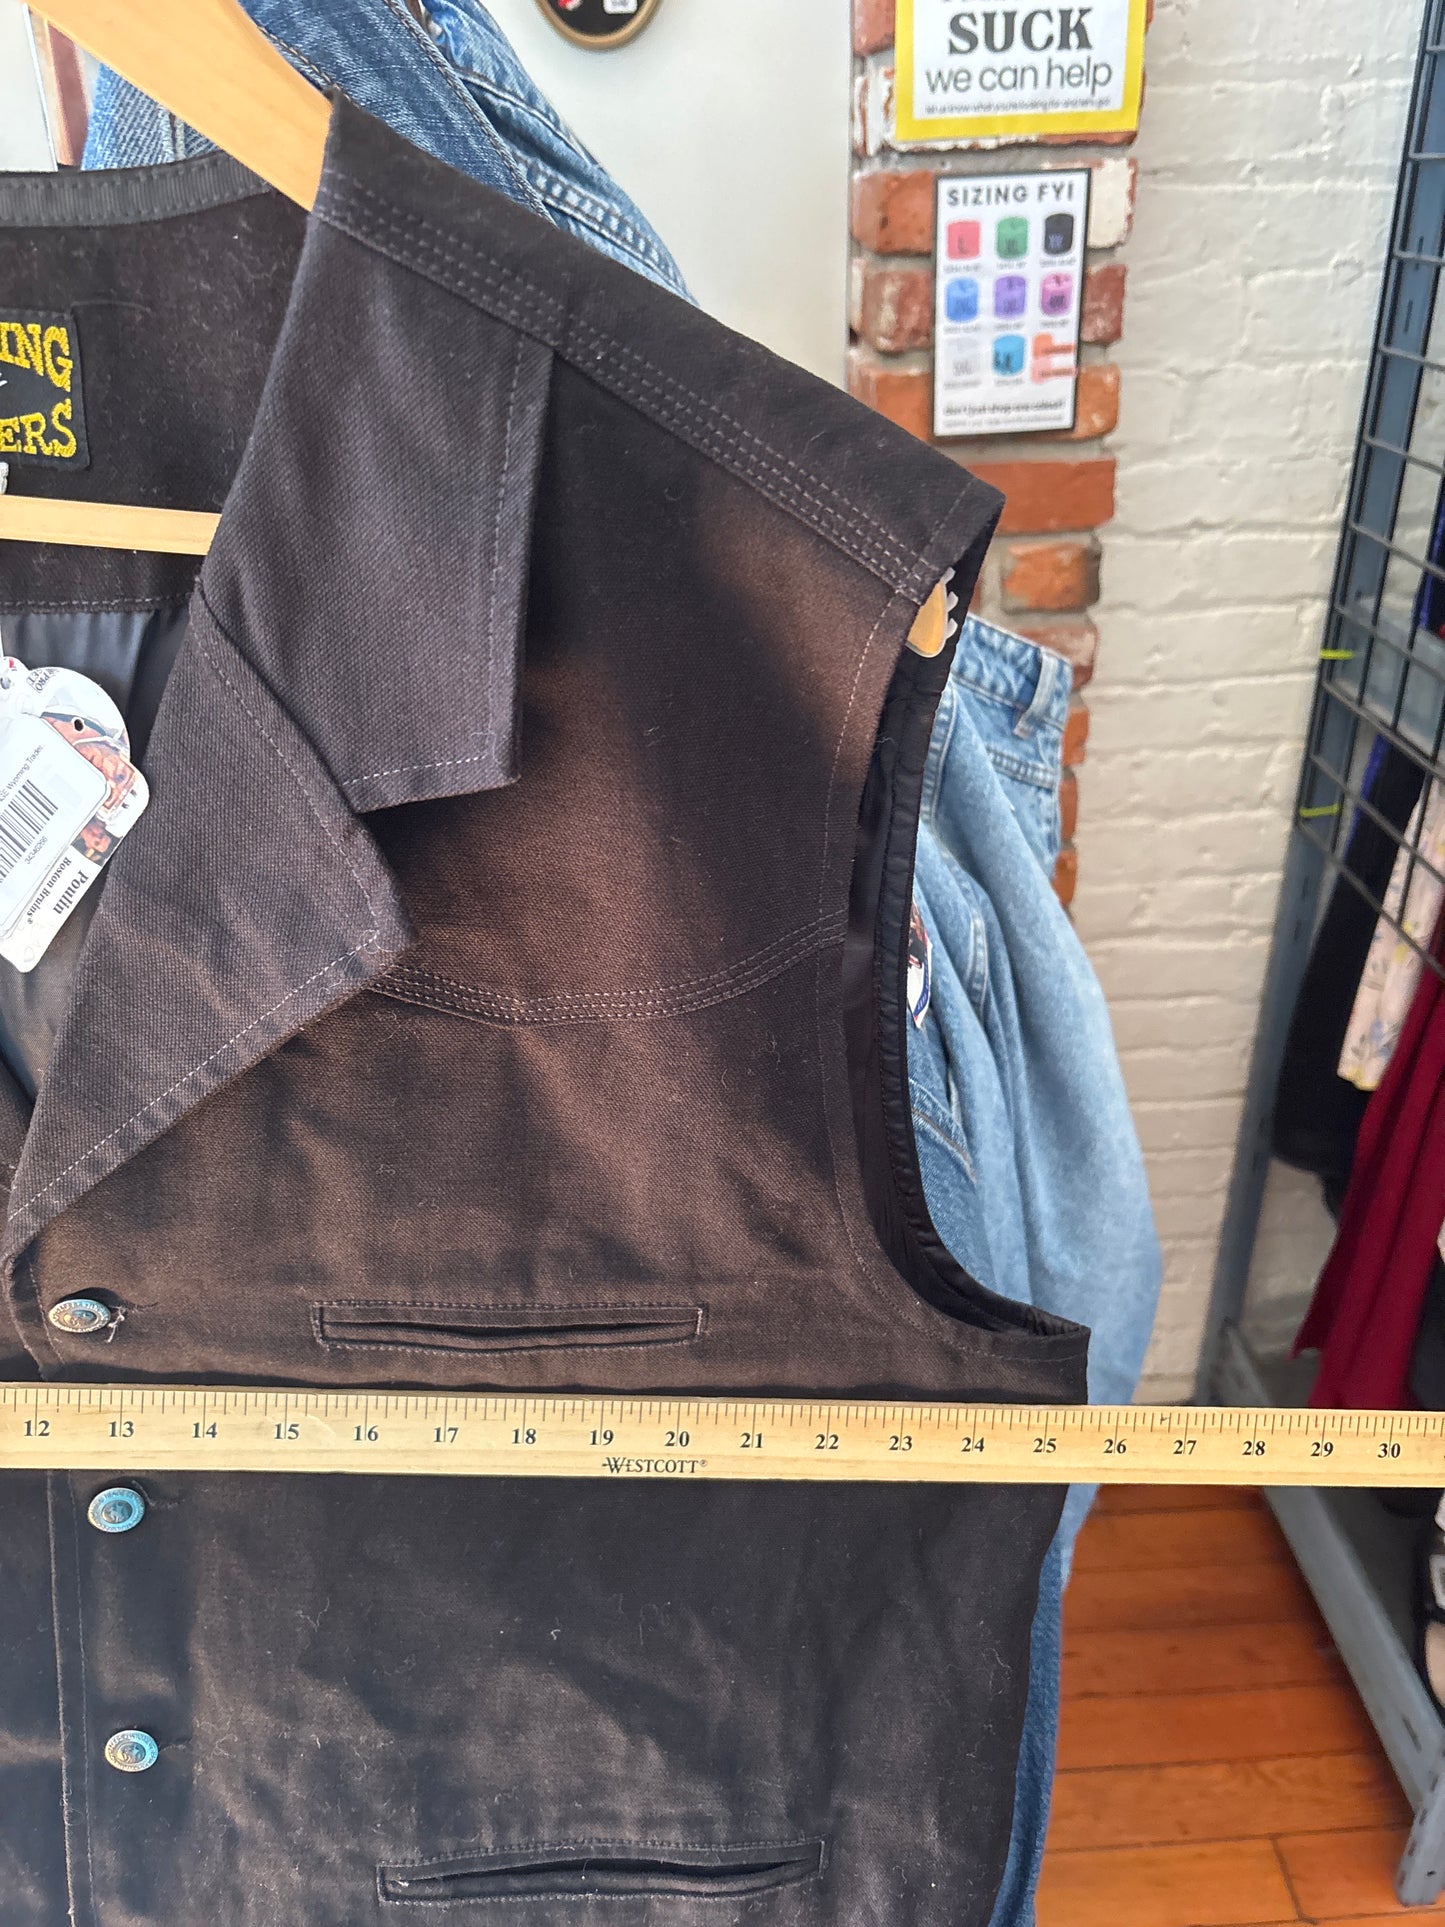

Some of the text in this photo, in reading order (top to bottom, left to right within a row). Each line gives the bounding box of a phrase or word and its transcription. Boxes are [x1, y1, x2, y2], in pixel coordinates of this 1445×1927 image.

[949, 7, 1093, 55] SUCK
[925, 55, 1112, 95] we can help
[948, 180, 1074, 206] SIZING FYI
[47, 856, 72, 889] Boston
[53, 870, 89, 915] Poulin
[24, 1420, 1401, 1459] 12 13 14 15 16 17 18 19 20 21 22 23 24 25 26 27 28 29 30
